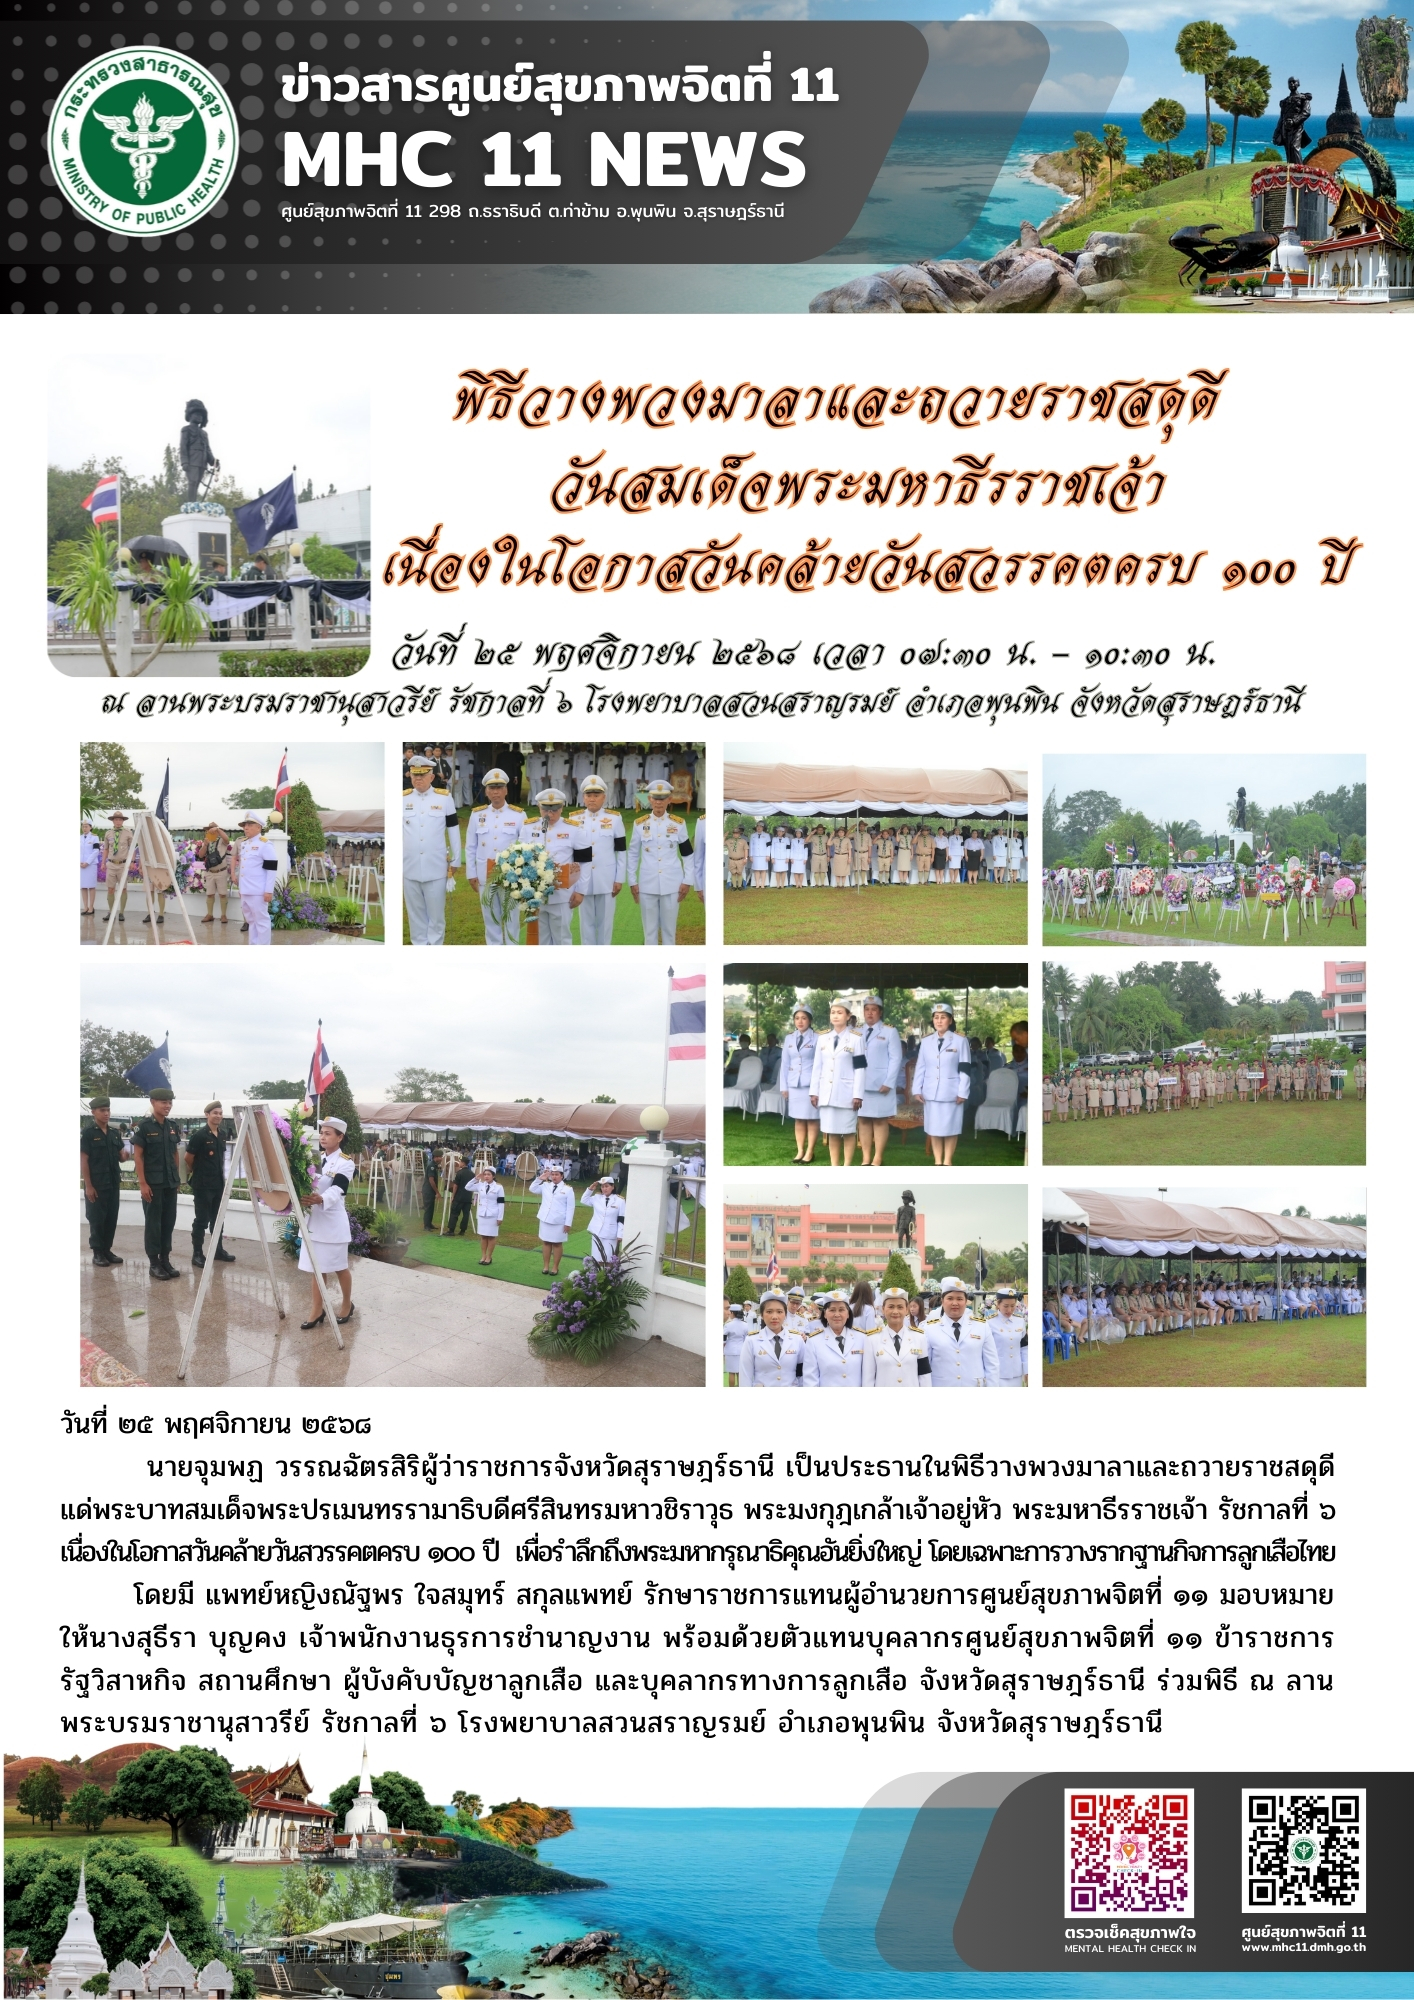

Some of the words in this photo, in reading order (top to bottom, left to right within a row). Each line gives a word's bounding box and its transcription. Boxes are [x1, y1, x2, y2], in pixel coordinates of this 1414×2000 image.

[64, 57, 223, 118] กระทรวงสาธารณสุข
[281, 51, 772, 117] ข่าวสารศูนย์สุขภาพจิตที่
[791, 67, 840, 102] 11
[284, 130, 453, 188] MHC
[482, 131, 562, 187] 11
[590, 130, 806, 188] NEWS
[62, 157, 110, 213] MINISTRY
[112, 208, 131, 223] OF
[136, 203, 187, 225] PUBLIC
[187, 158, 225, 207] HEALTH
[281, 198, 398, 223] ศูนย์สุขภาพจิตที่
[405, 204, 422, 218] 11
[429, 204, 462, 218] 298
[468, 201, 541, 218] ถ.ธราธิบดี
[548, 202, 610, 218] ต.ท่าข้าม
[616, 203, 676, 223] อ.พุนพิน
[683, 201, 785, 223] จ.สุราษฎร์ธานี
[452, 367, 1231, 445] พิธีวางพวงมาลาและถวายราชสดุดี
[549, 449, 1168, 515] วันสมเด็จพระมหาธีรราชเจ้า
[382, 522, 1209, 594] เนื่องในโอกาสวันคล้ายวันสวรรคตครบ
[1221, 558, 1298, 592] ๑๐๐
[1317, 535, 1364, 586] ปี
[391, 622, 468, 671] วันที่
[474, 638, 523, 666] ๒๕
[532, 632, 702, 673] พฤศจิกายน
[712, 638, 802, 666] ๒๕๖๘
[813, 642, 885, 671] เวลา
[900, 638, 991, 668] ๐๗:๓๐
[1006, 640, 1036, 666] น.
[1085, 647, 1171, 669] ๑๐:๓๐
[1185, 640, 1215, 666] น.
[102, 692, 130, 714] ณ
[136, 684, 442, 727] ลานพระบรมราชานุสาวรีย์
[449, 677, 552, 718] รัชกาลที่
[556, 690, 573, 714] ๖
[585, 683, 901, 719] โรงพยาบาลสวนสราญรมย์
[905, 685, 1065, 727] อำเภอพุนพิน
[1070, 682, 1308, 727] จังหวัดสุราษฎร์ธานี
[60, 1404, 107, 1434] วันที่
[118, 1415, 154, 1434] ๒๕
[164, 1410, 291, 1440] พฤศจิกายน
[302, 1415, 372, 1434] ๒๕๖๘
[146, 1459, 263, 1486] นายจุมพฏ
[275, 1452, 774, 1486] วรรณฉัตรสิริผู้ว่าราชการจังหวัดสุราษฎร์ธานี
[786, 1451, 1334, 1486] เป็นประธานในพิธีวางพวงมาลาและถวายราชสดุดี
[61, 1494, 733, 1529] แด่พระบาทสมเด็จพระปรเมนทรรามาธิบดีศรีสินทรมหาวชิราวุธ
[743, 1495, 1002, 1529] พระมงกุฎเกล้าเจ้าอยู่หัว
[1012, 1495, 1207, 1520] พระมหาธีรราชเจ้า
[1218, 1490, 1308, 1520] รัชกาลที่
[1319, 1502, 1336, 1520] ๖
[61, 1532, 420, 1562] เนื่องในโอกาสวันคล้ายวันสวรรคตครบ
[427, 1546, 476, 1564] ๑๐๐
[482, 1537, 500, 1562] ปี
[516, 1532, 922, 1571] เพื่อรำลึกถึงพระมหากรุณาธิคุณอันยิ่งใหญ่
[927, 1537, 1336, 1571] โดยเฉพาะการวางรากฐานกิจการลูกเสือไทย
[132, 1580, 194, 1605] โดยมี
[206, 1580, 404, 1613] แพทย์หญิงณัฐพร
[413, 1580, 506, 1614] ใจสมุทร์
[516, 1580, 634, 1614] สกุลแพทย์
[644, 1575, 1162, 1614] รักษาราชการแทนผู้อำนวยการศูนย์สุขภาพจิตที่
[1173, 1589, 1208, 1607] ๑๑
[1219, 1587, 1333, 1605] มอบหมาย
[58, 1623, 196, 1657] ให้นางสุธีรา
[208, 1630, 286, 1657] บุญคง
[300, 1623, 650, 1657] เจ้าพนักงานธุรการชำนาญงาน
[663, 1618, 1154, 1657] พร้อมด้วยตัวแทนบุคลากรศูนย์สุขภาพจิตที่
[1167, 1632, 1203, 1650] ๑๑
[1215, 1623, 1334, 1648] ข้าราชการ
[60, 1666, 186, 1699] รัฐวิสาหกิจ
[198, 1665, 331, 1691] สถานศึกษา
[344, 1666, 582, 1700] ผู้บังคับบัญชาลูกเสือ
[595, 1666, 907, 1700] และบุคลากรทางการลูกเสือ
[920, 1666, 1145, 1700] จังหวัดสุราษฎร์ธานี
[1157, 1666, 1238, 1691] ร่วมพิธี
[1250, 1673, 1274, 1691] ณ
[1286, 1673, 1333, 1691] ลาน
[60, 1708, 311, 1742] พระบรมราชานุสาวรีย์
[322, 1703, 417, 1733] รัชกาลที่
[429, 1715, 447, 1733] ๖
[457, 1708, 767, 1739] โรงพยาบาลสวนสราญรมย์
[778, 1708, 925, 1742] อำเภอพุนพิน
[937, 1708, 1162, 1742] จังหวัดสุราษฎร์ธานี
[1064, 1923, 1197, 1943] ตรวจเช็คสุขภาพใจ
[1064, 1944, 1105, 1953] MENTAL
[1107, 1944, 1147, 1953] HEALTH
[1150, 1944, 1183, 1953] CHECK
[1186, 1944, 1197, 1953] IN
[1241, 1920, 1346, 1942] ศูนย์สุขภาพจิตที่
[1351, 1925, 1367, 1938] 11
[1241, 1942, 1367, 1954] www.mhc11.dmh.go.th
